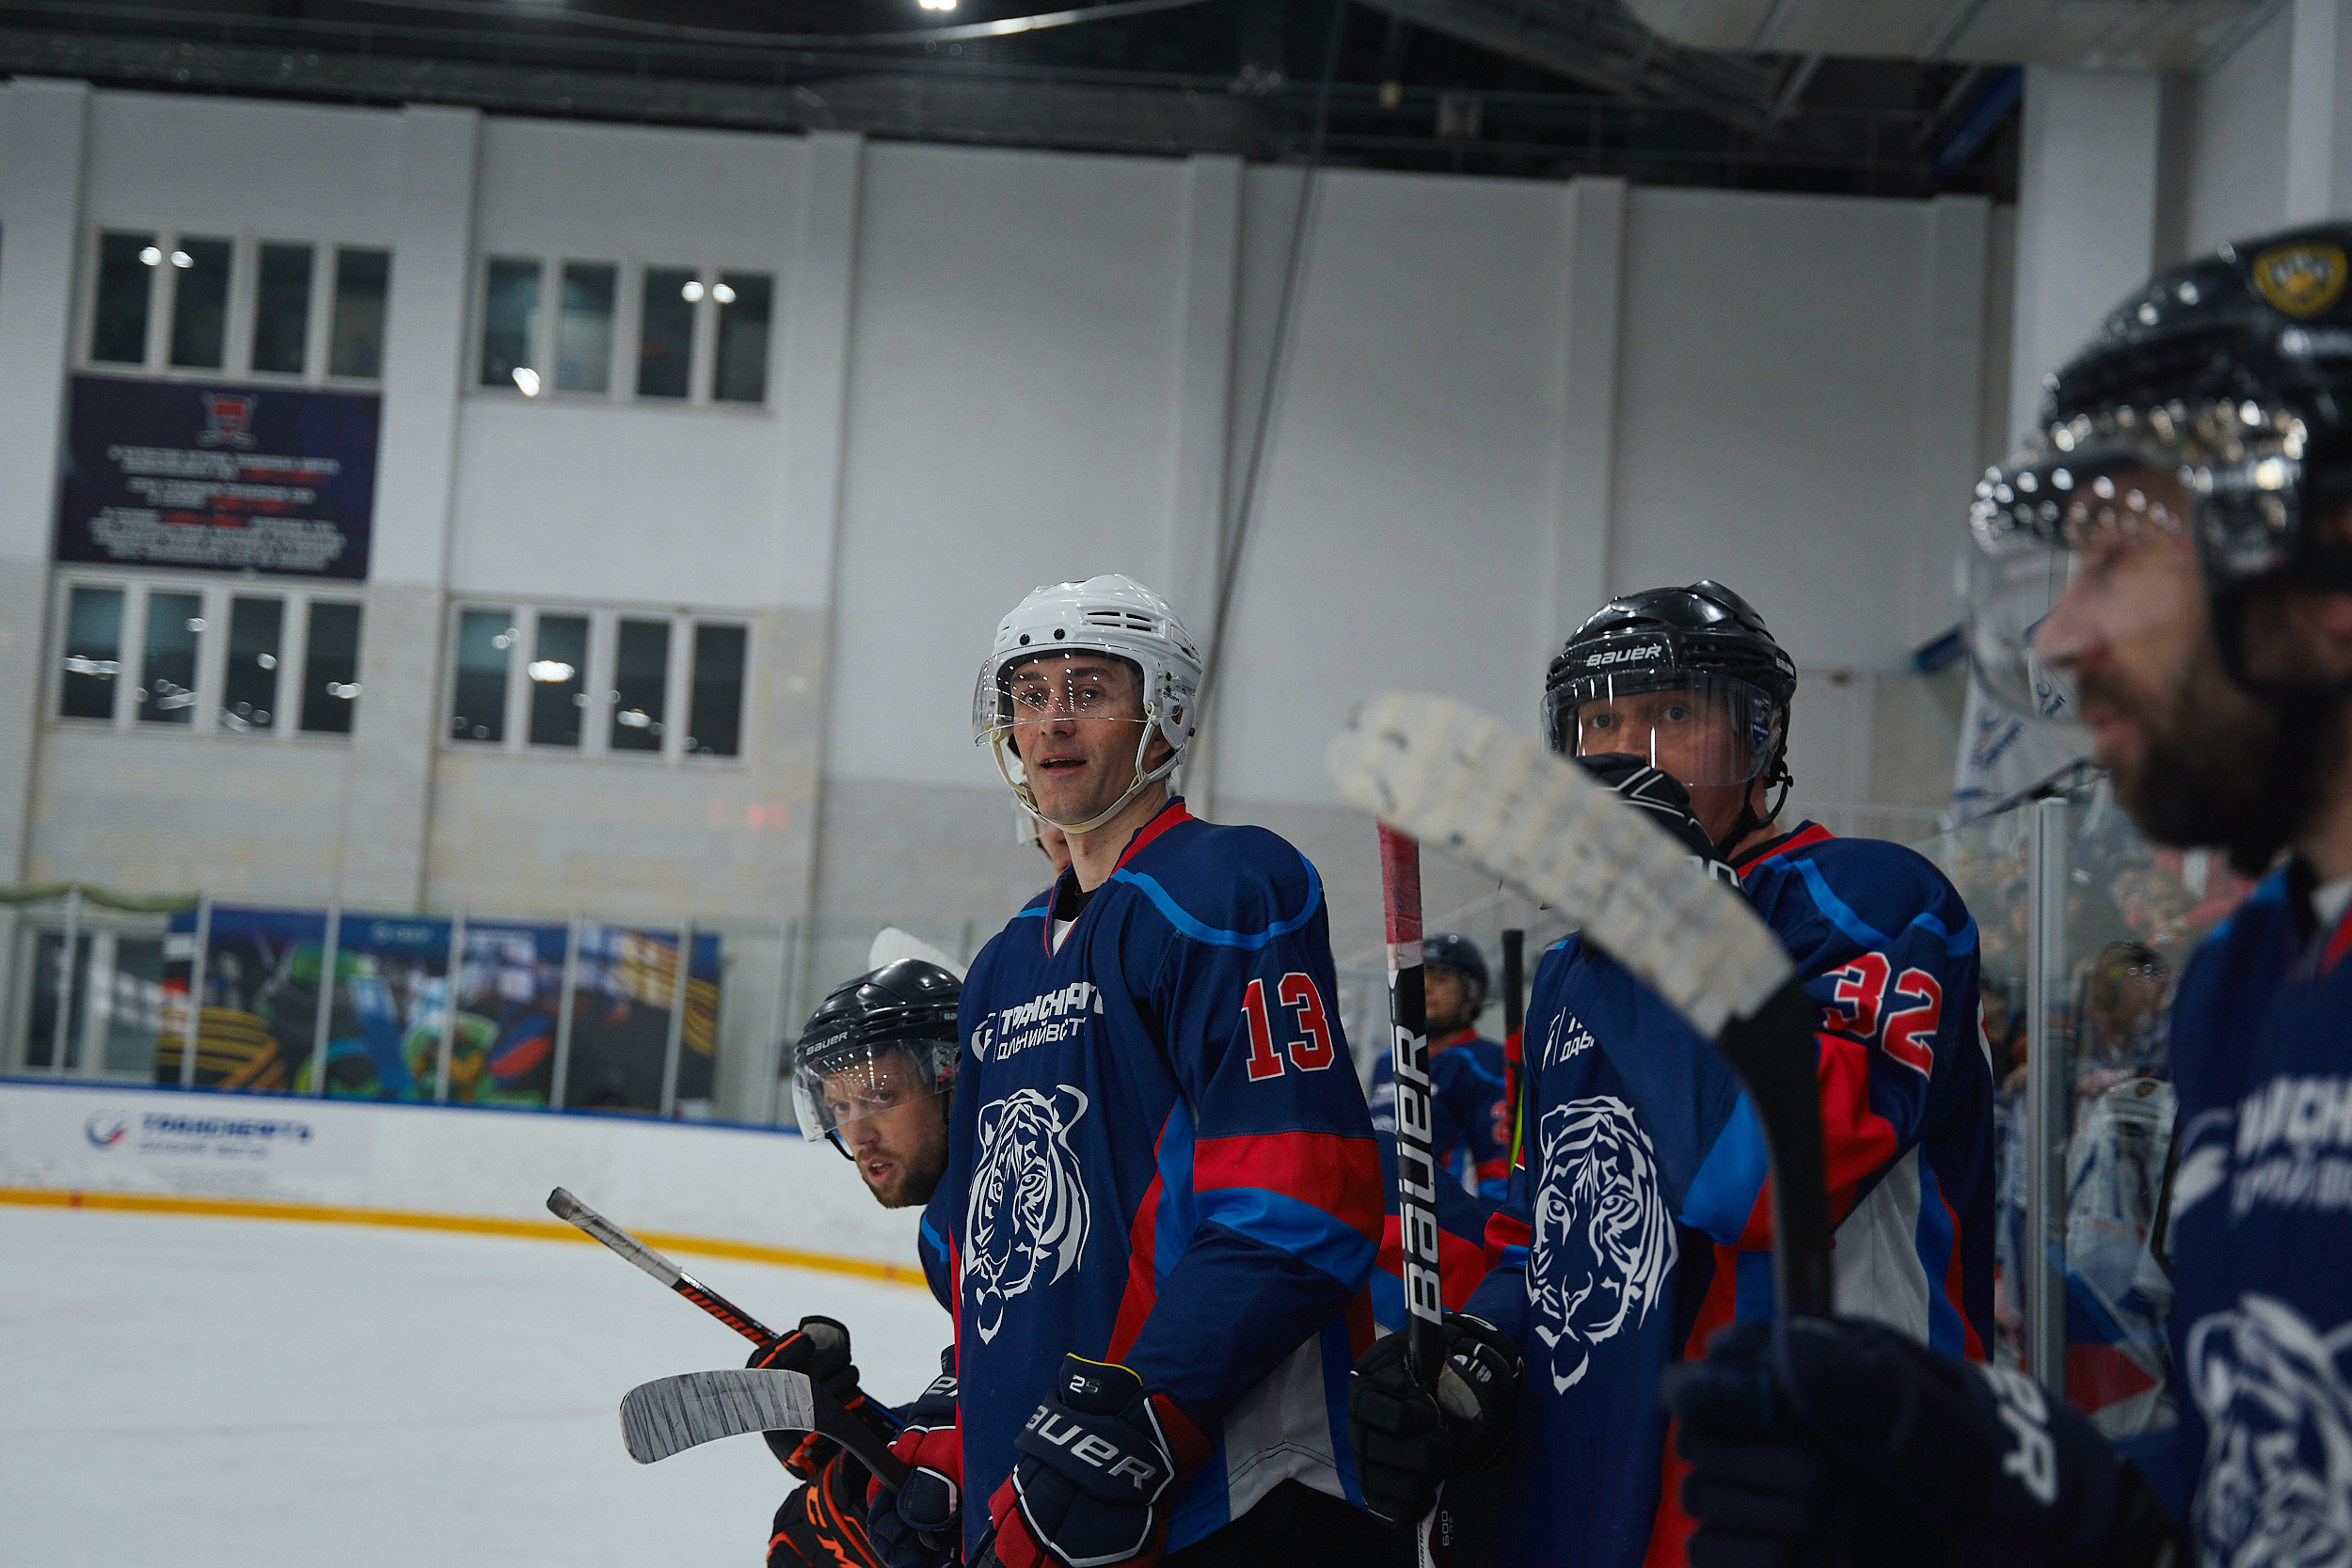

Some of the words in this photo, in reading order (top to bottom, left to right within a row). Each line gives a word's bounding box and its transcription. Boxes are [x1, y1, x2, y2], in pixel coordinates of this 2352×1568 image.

[1586, 645, 1662, 667] BAUER
[805, 1031, 849, 1056] BAUER
[1241, 972, 1335, 1082] 13
[1821, 951, 1943, 1082] 32
[1396, 1024, 1442, 1326] BAUER
[1025, 1404, 1157, 1490] AUER
